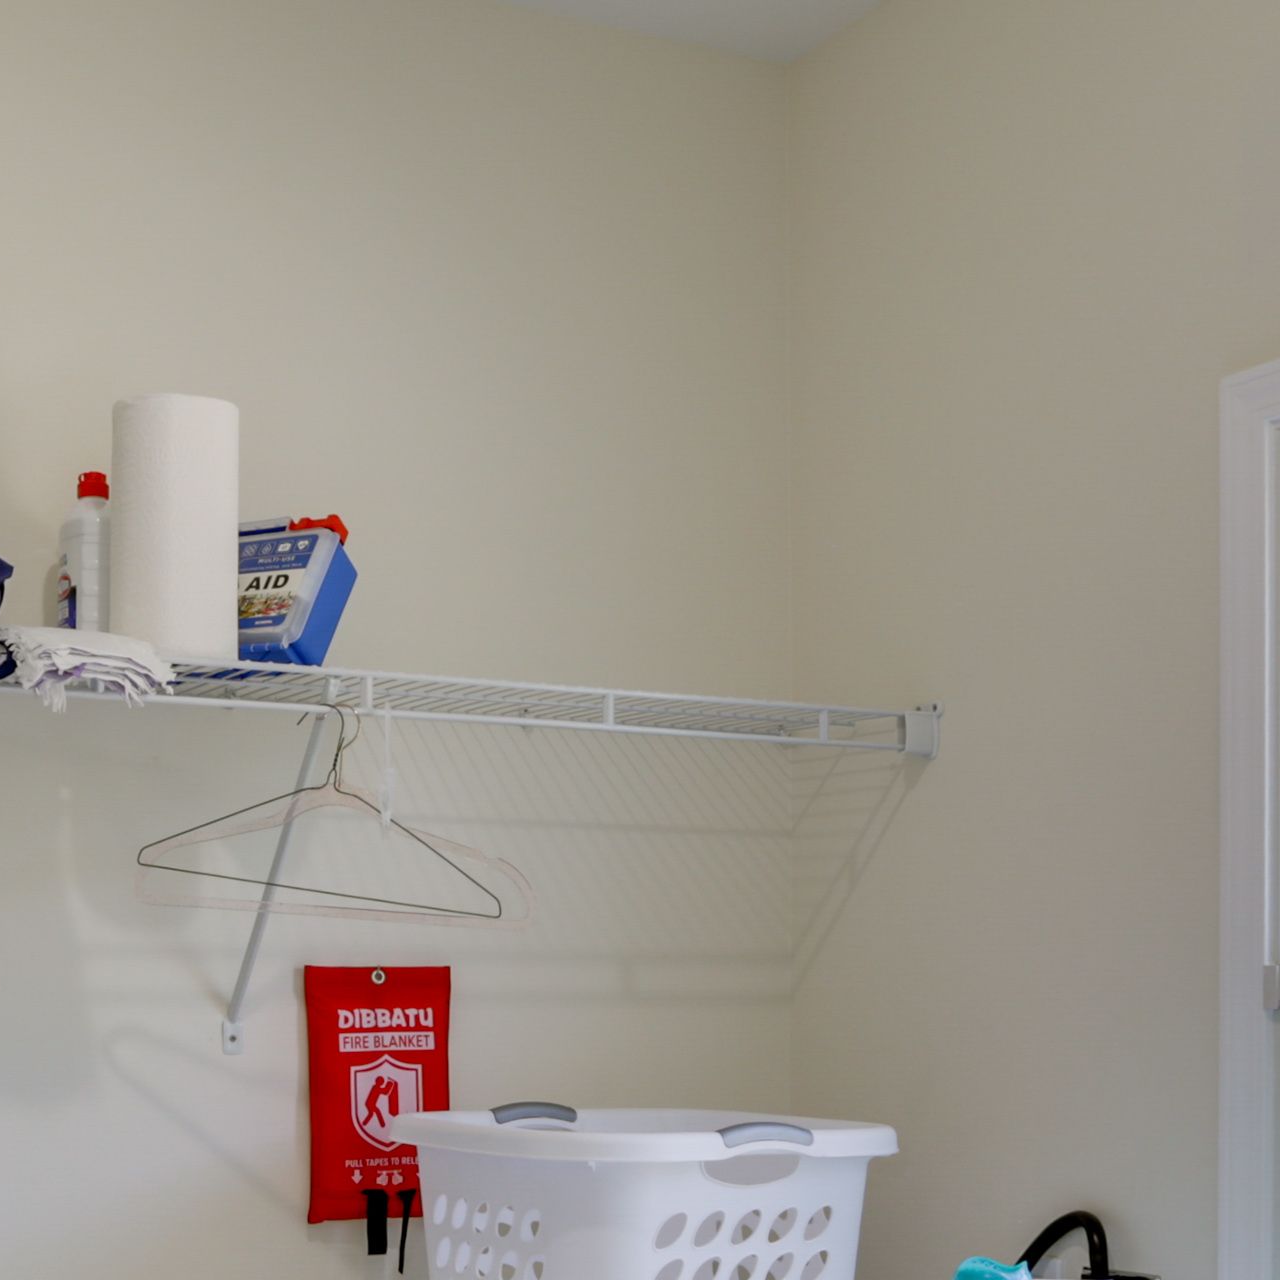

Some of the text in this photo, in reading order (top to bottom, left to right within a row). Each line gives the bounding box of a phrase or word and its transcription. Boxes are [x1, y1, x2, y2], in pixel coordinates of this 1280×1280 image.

[244, 574, 290, 592] AID
[337, 1007, 434, 1029] DIBBATU
[342, 1034, 431, 1049] FIRE BLANKET
[344, 1159, 364, 1168] PULL
[365, 1158, 389, 1167] TAPES
[390, 1156, 400, 1165] TO
